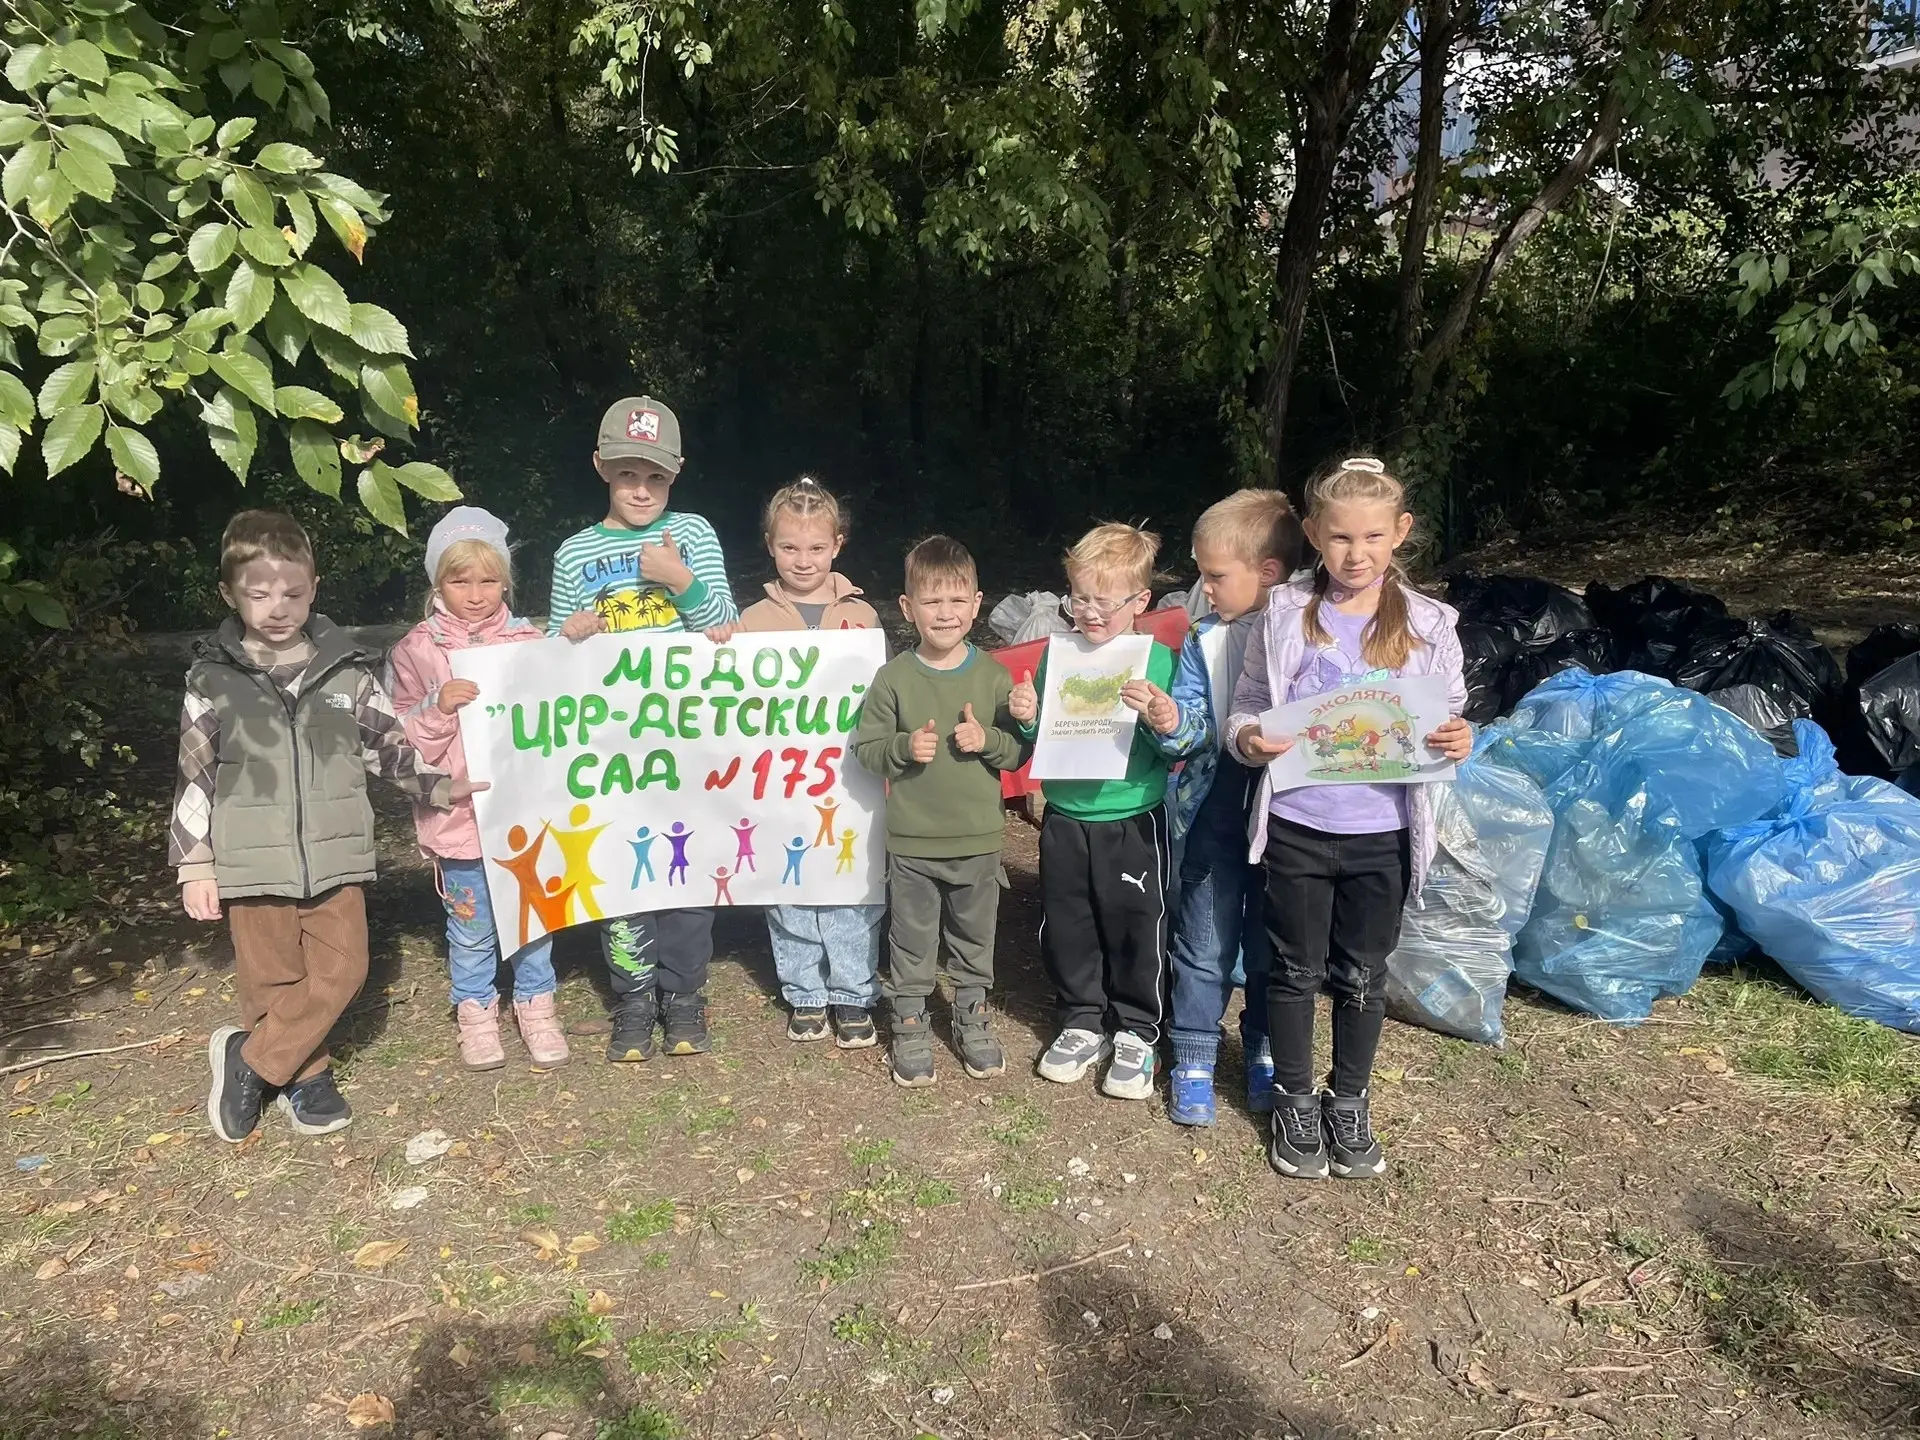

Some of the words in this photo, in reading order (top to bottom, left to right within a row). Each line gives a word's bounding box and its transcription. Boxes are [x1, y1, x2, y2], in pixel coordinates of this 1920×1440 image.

[582, 542, 691, 582] CALIFA
[602, 646, 820, 692] МБДОУ
[1308, 688, 1402, 717] ЭКОЛЯТА
[1054, 720, 1080, 728] БЕРЕЧЬ
[1097, 727, 1122, 735] РОДИНУ
[567, 749, 681, 799] САД
